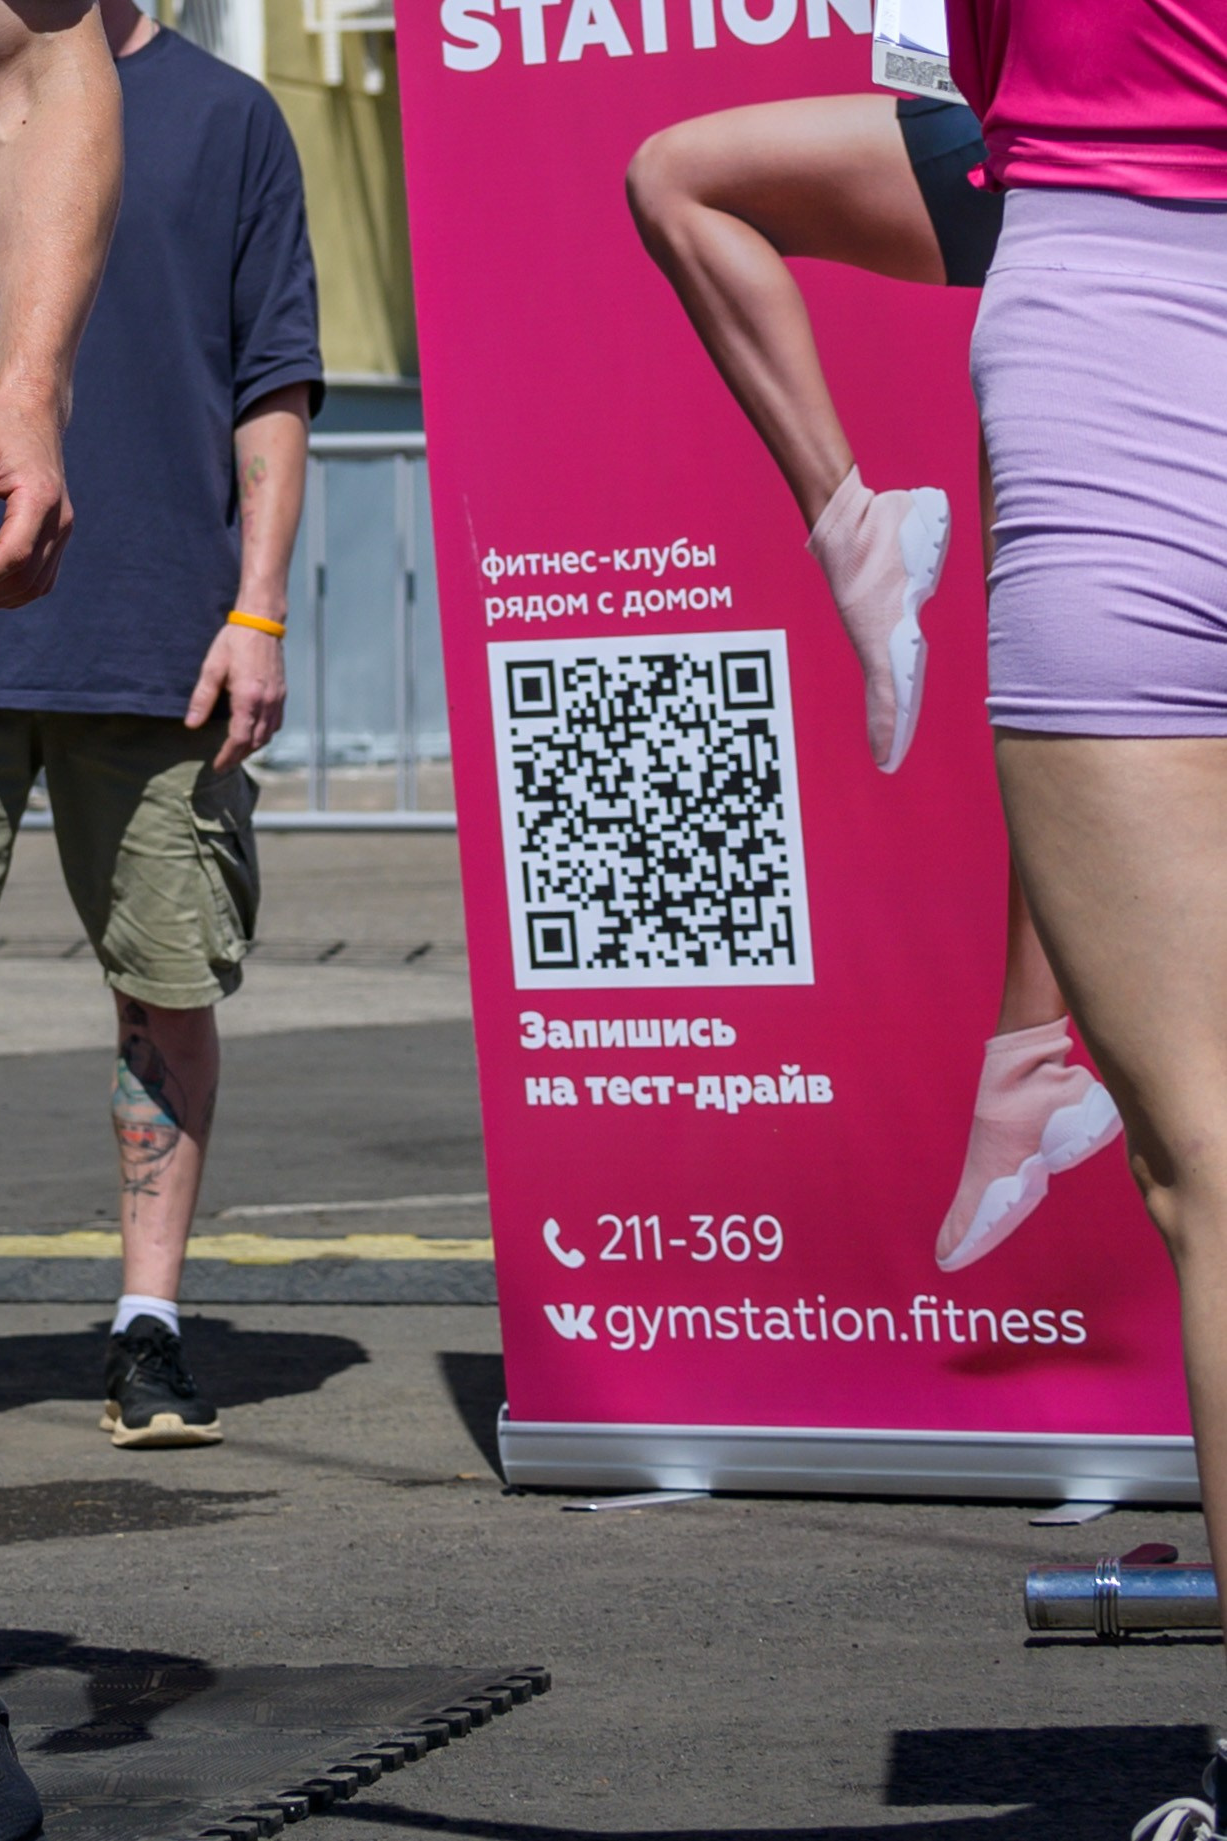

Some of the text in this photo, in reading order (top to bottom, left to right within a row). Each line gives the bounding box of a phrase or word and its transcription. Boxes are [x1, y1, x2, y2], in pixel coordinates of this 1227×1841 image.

[481, 537, 716, 585] фитнес-клубы
[484, 585, 733, 627] рядом с домом
[520, 1010, 736, 1050] Запишись
[525, 1064, 834, 1114] на тест-драйв
[597, 1214, 784, 1262] 211-369
[605, 1295, 1087, 1351] gymstation.fitness
